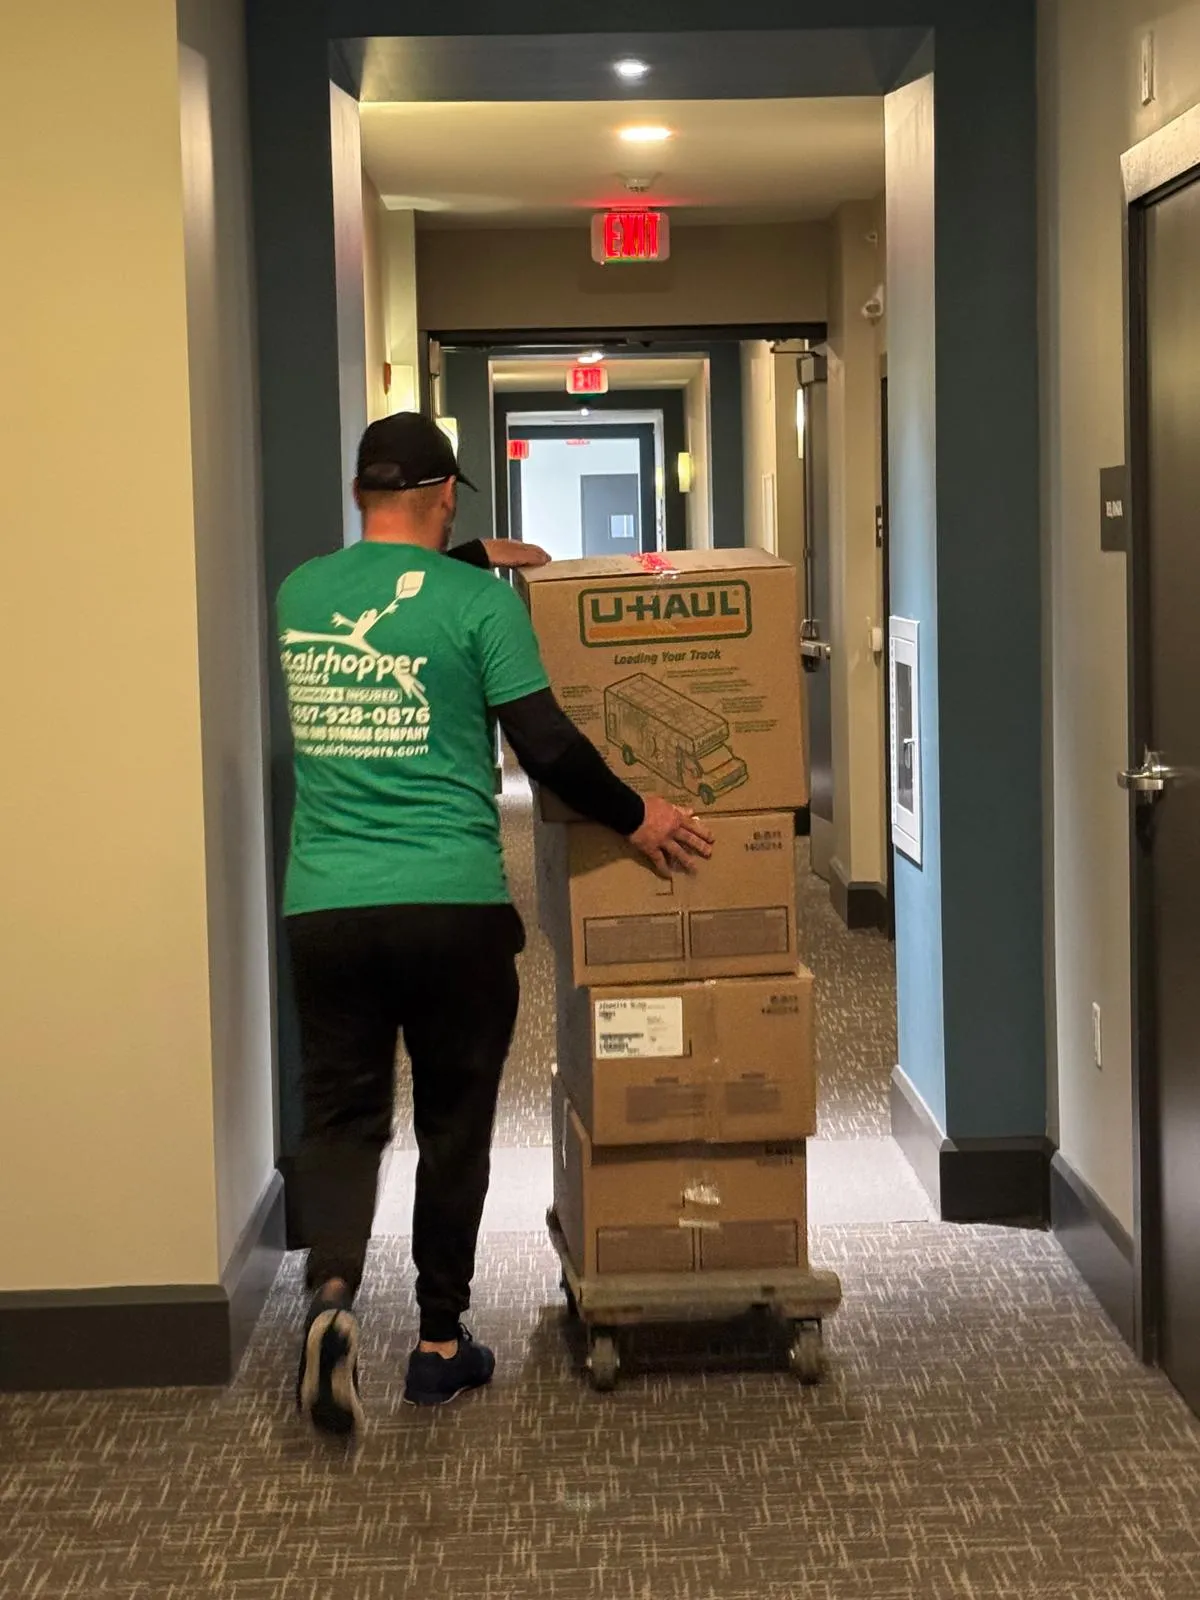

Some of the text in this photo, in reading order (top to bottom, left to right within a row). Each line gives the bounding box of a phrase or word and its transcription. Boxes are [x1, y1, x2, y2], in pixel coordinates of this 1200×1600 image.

[604, 213, 660, 258] EXIT
[614, 652, 658, 665] Loading
[662, 650, 686, 662] Your
